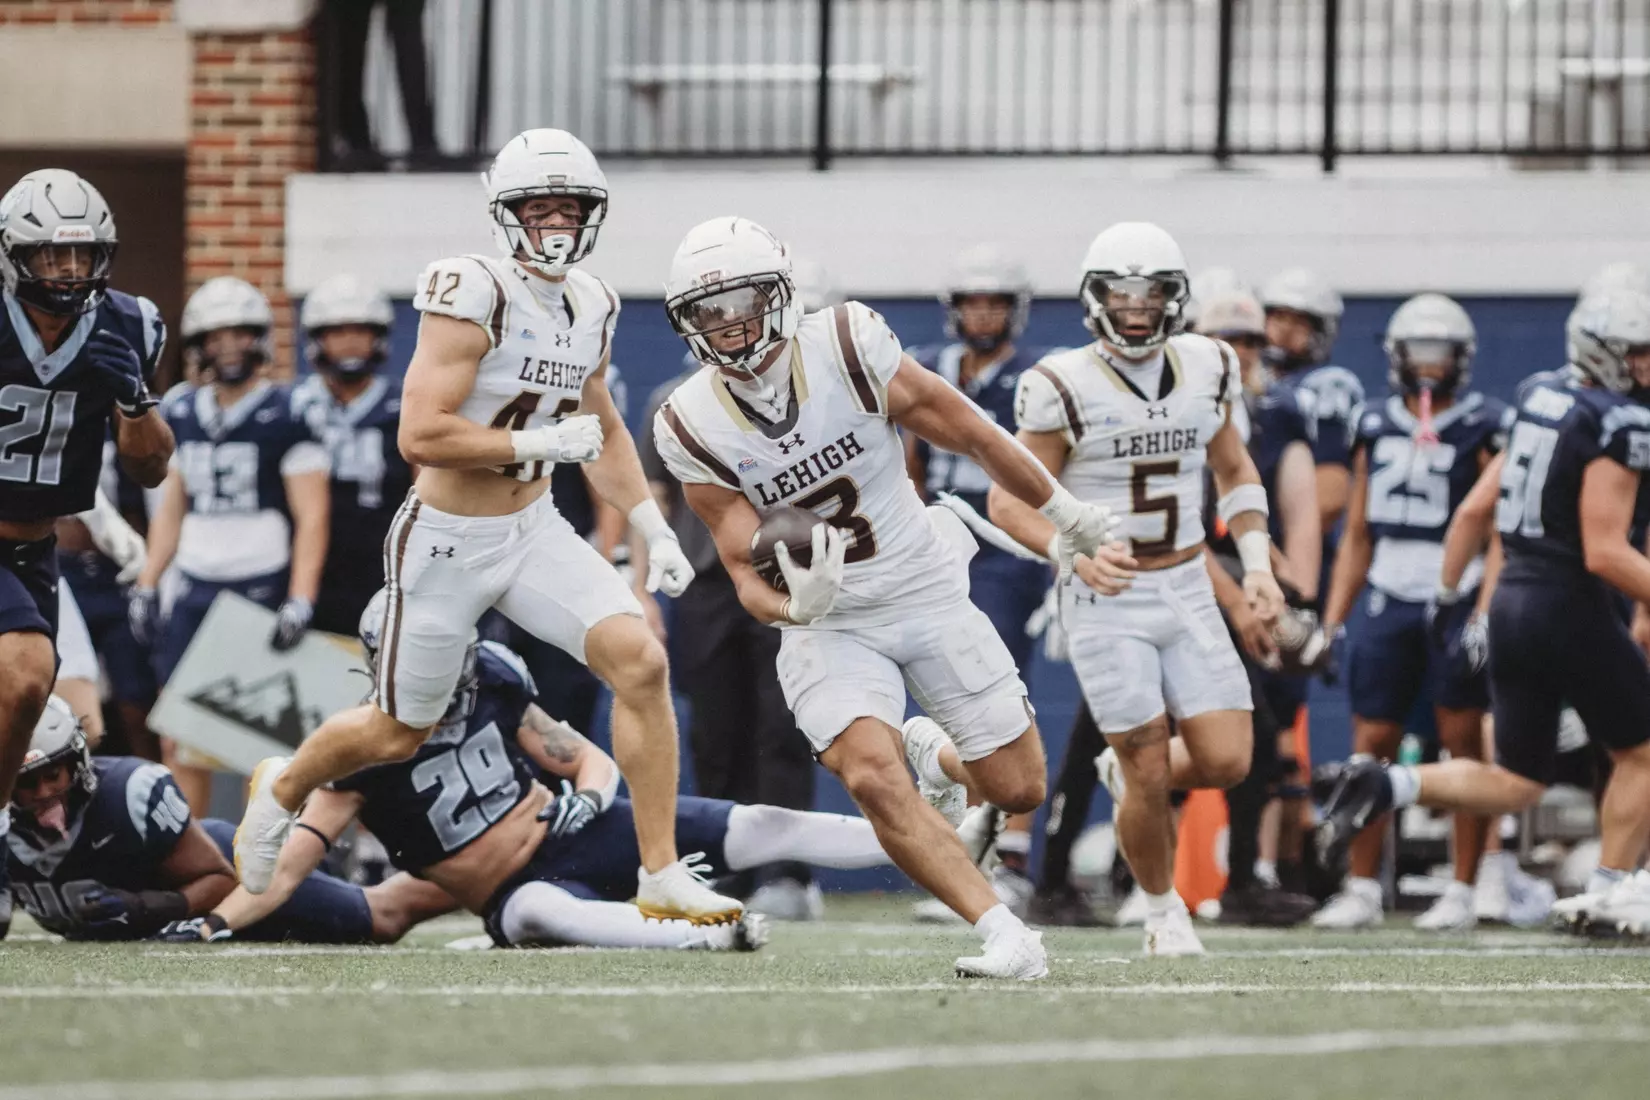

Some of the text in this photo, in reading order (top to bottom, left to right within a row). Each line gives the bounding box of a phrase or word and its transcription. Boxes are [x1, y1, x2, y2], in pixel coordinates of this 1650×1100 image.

[426, 270, 461, 305] 42
[519, 356, 587, 390] LEHIGH
[0, 384, 78, 485] 21
[754, 431, 865, 507] LEHIGH
[1113, 428, 1199, 458] LEHIGH
[788, 473, 879, 565] 3
[1129, 458, 1181, 557] 5
[1366, 435, 1457, 528] 25
[411, 721, 521, 852] 29
